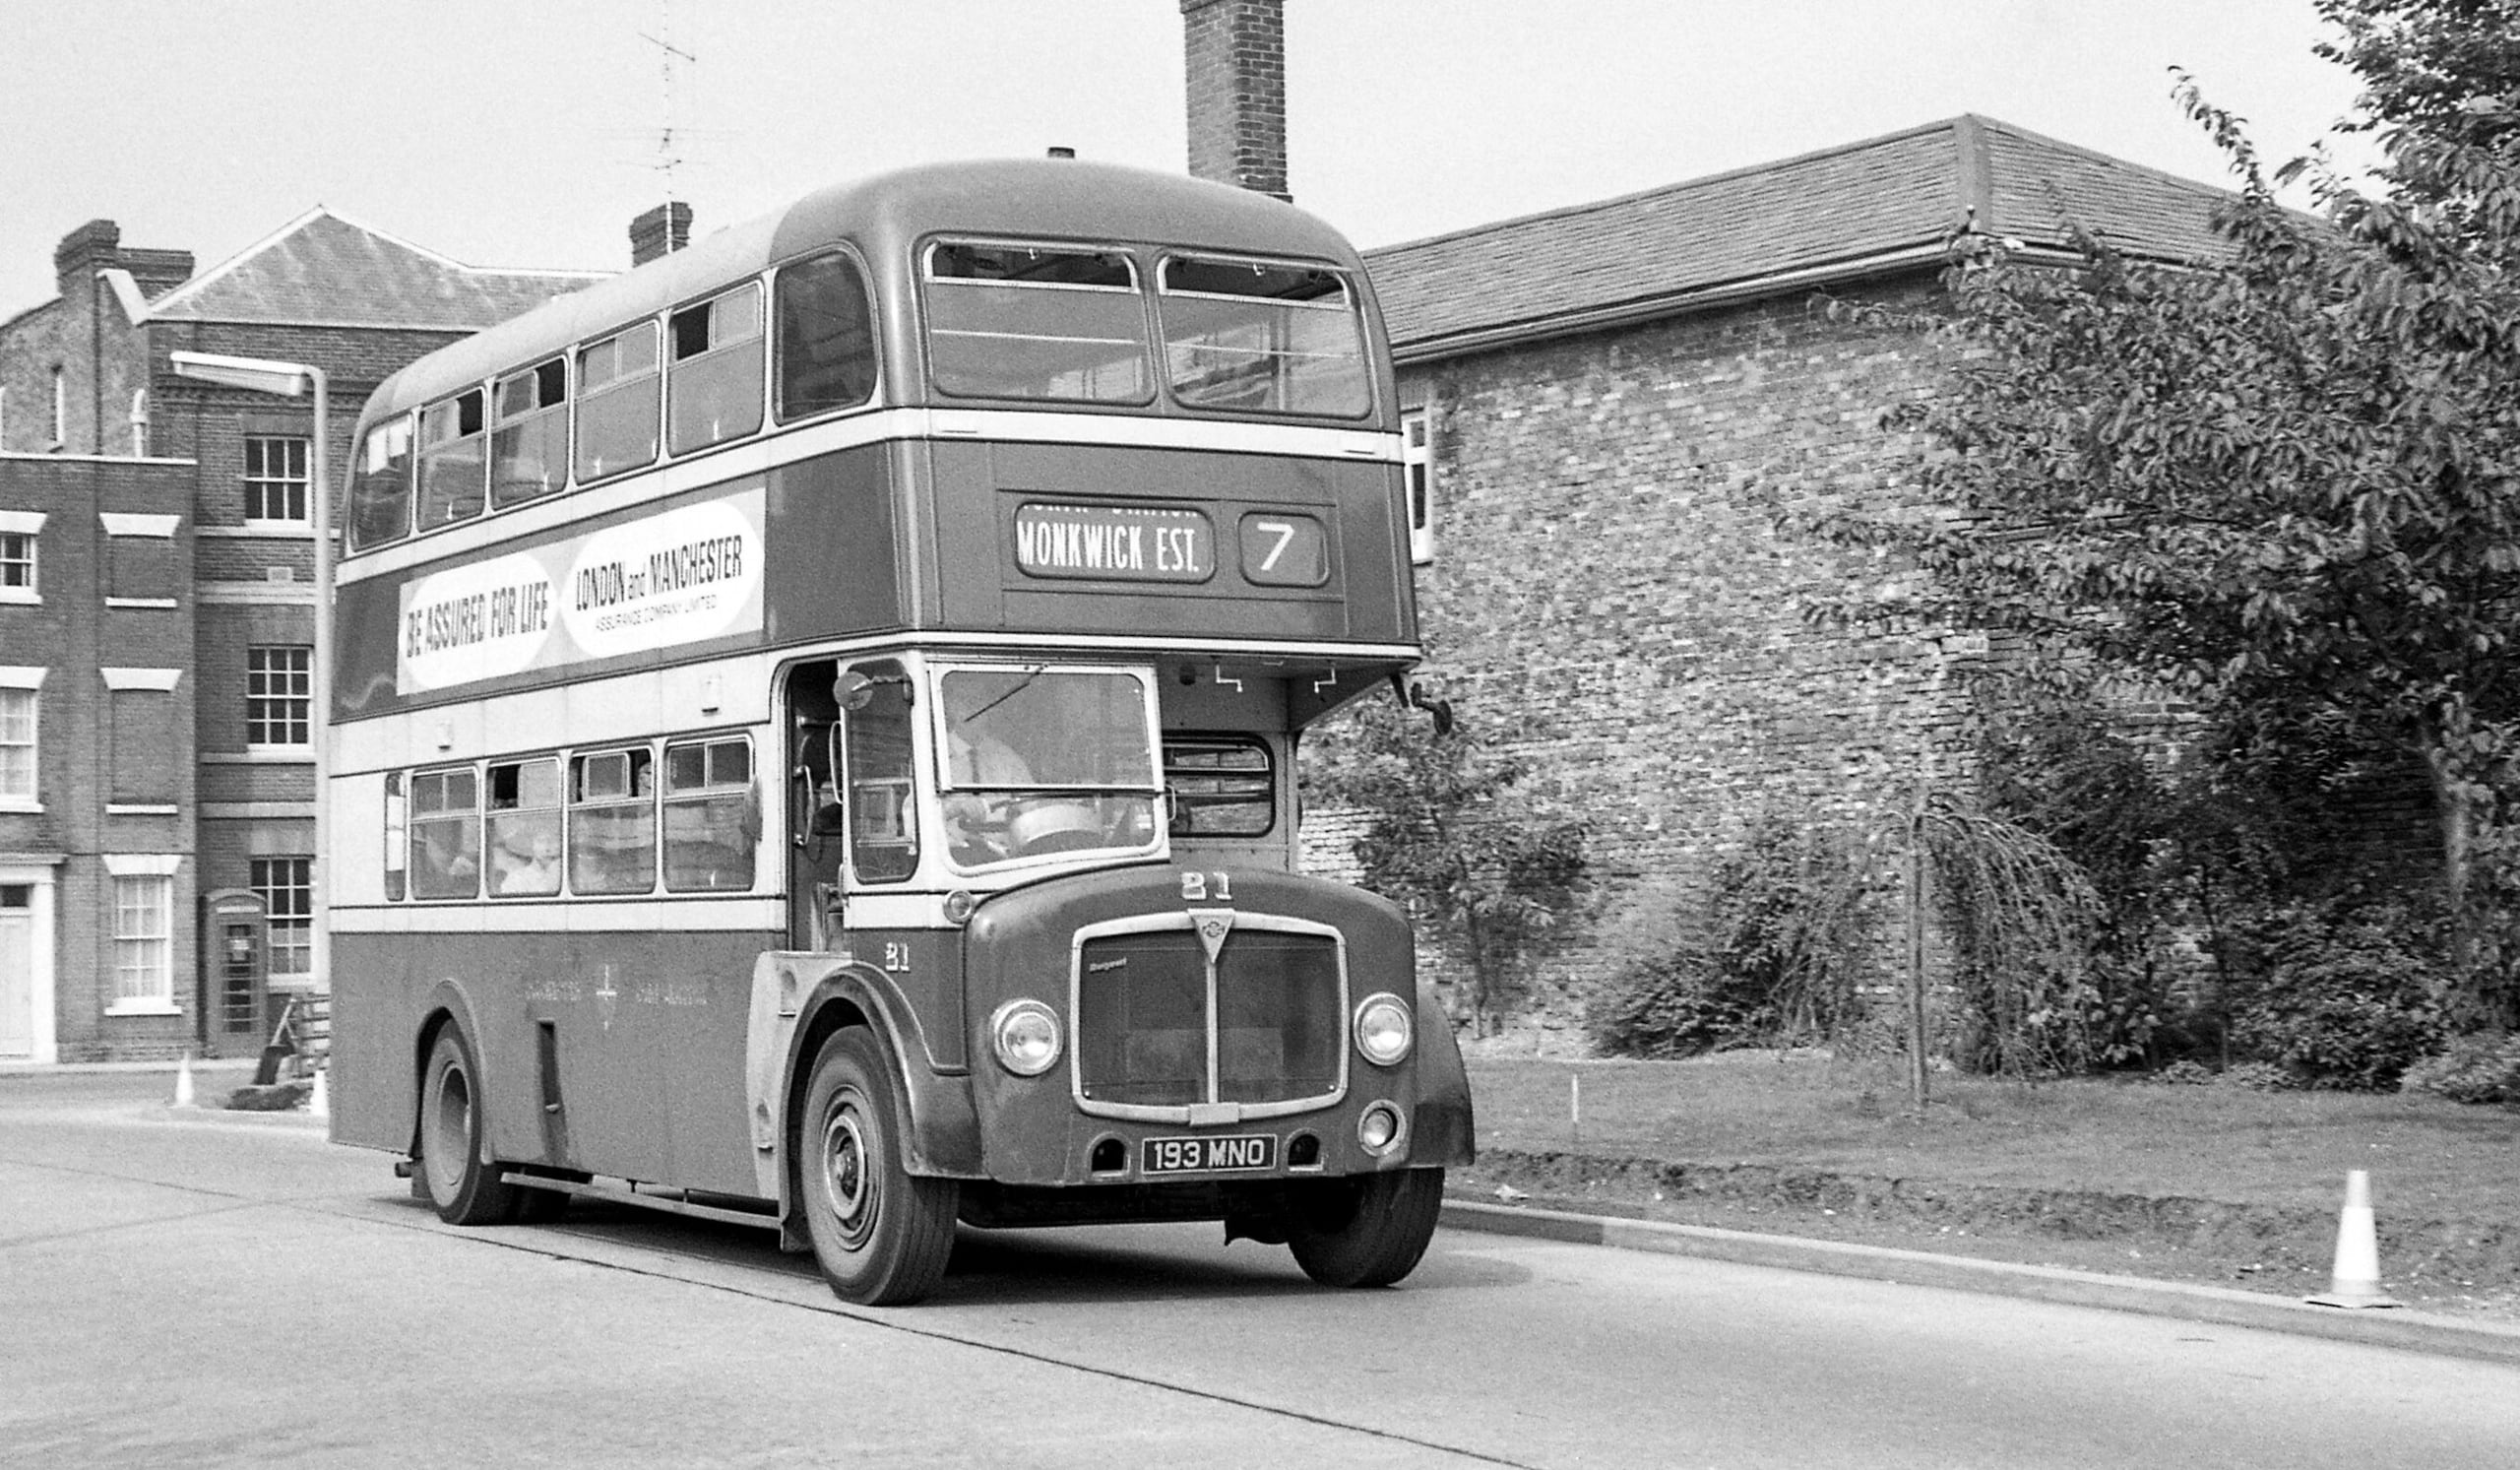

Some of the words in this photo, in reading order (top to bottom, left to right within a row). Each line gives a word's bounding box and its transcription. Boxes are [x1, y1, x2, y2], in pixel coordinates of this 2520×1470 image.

[1017, 521, 1143, 570] MONKWICK
[1156, 527, 1200, 572] EST.
[1257, 522, 1295, 571] 7
[576, 560, 626, 611] LONDON
[628, 562, 647, 601] and
[649, 535, 742, 596] MANCHESTER
[407, 607, 422, 659] BE
[424, 593, 485, 654] ASSURED
[491, 587, 517, 639] FOR
[520, 581, 548, 634] LIFE
[1155, 1141, 1201, 1170] 193
[1208, 1139, 1265, 1167] MNO
